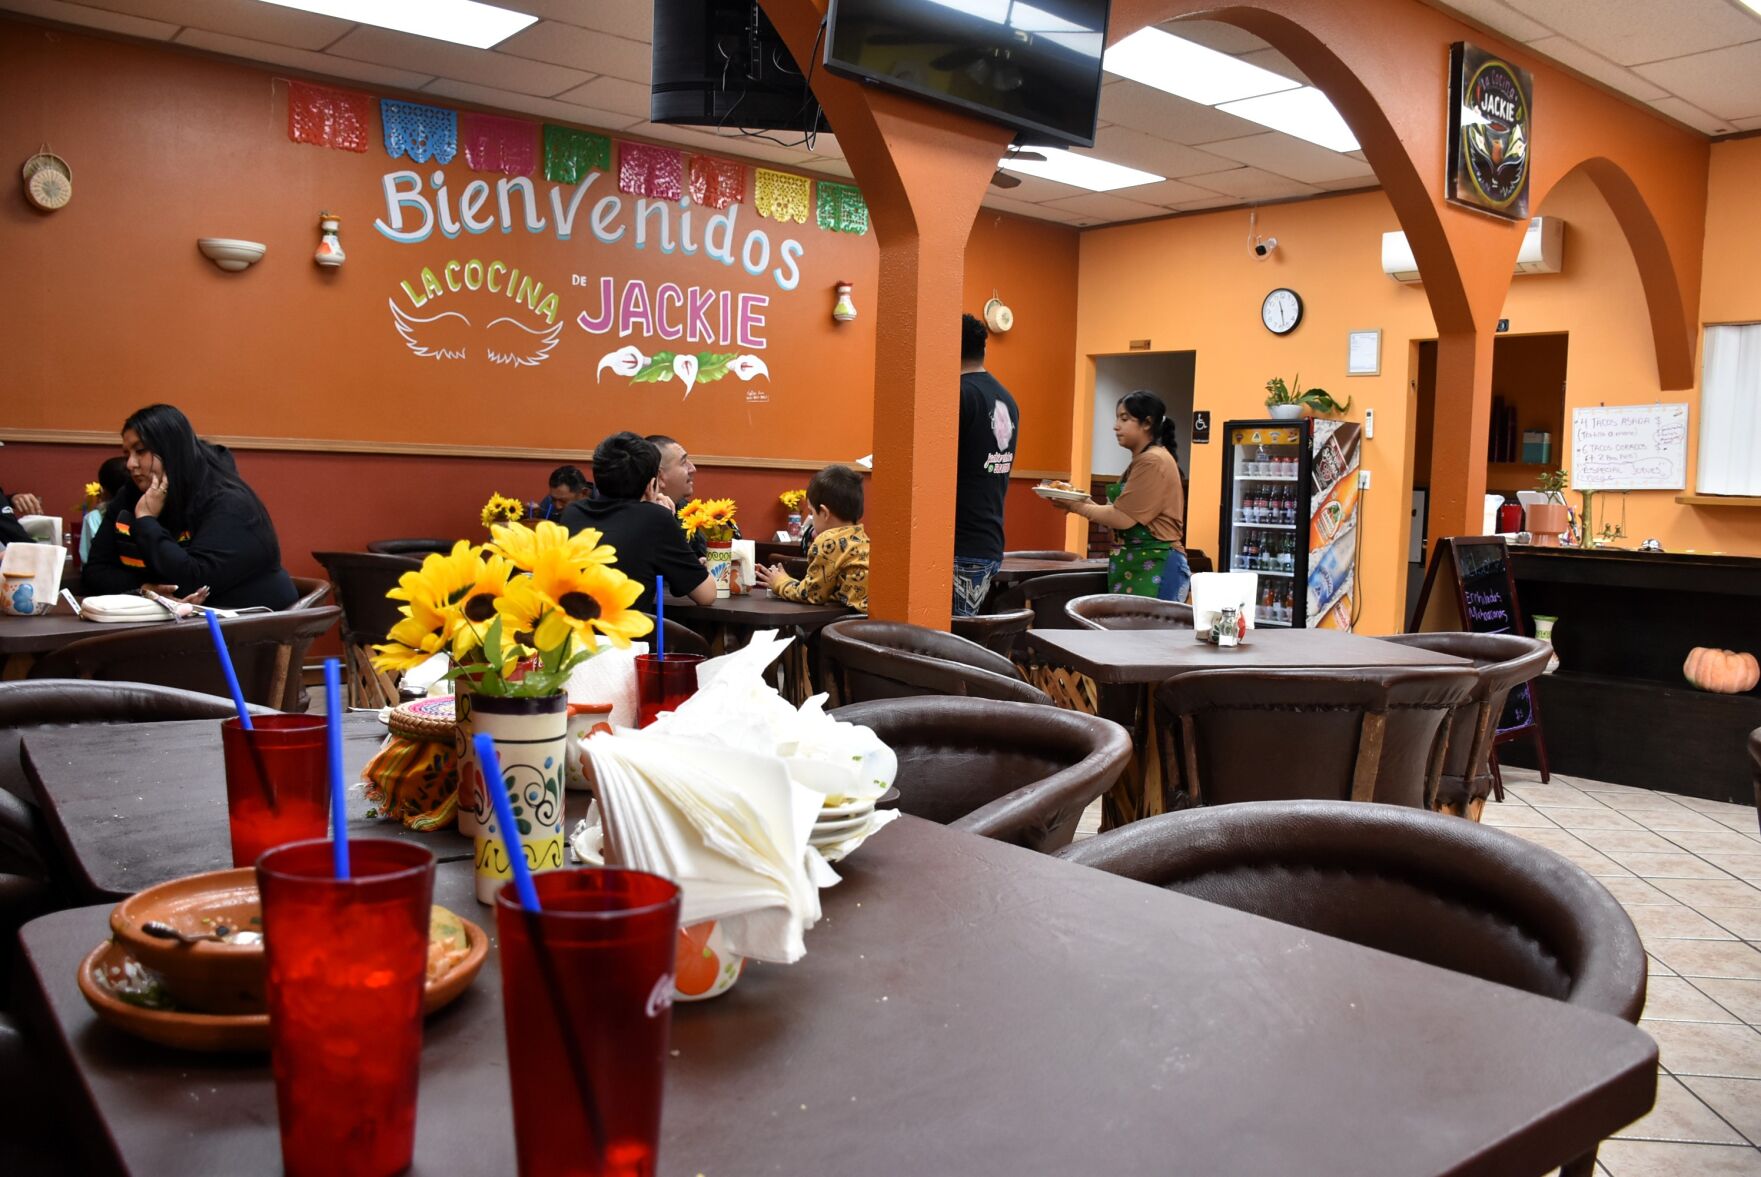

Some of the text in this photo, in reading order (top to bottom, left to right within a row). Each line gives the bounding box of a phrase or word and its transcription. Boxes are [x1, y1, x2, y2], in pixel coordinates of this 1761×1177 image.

[1481, 93, 1515, 122] JACKIE
[373, 170, 803, 291] Bienvenidos
[400, 259, 770, 349] LA COCINA DE JACKIE
[1592, 417, 1618, 429] TACOS
[1621, 416, 1650, 427] ASADA
[1591, 444, 1614, 452] TACOS
